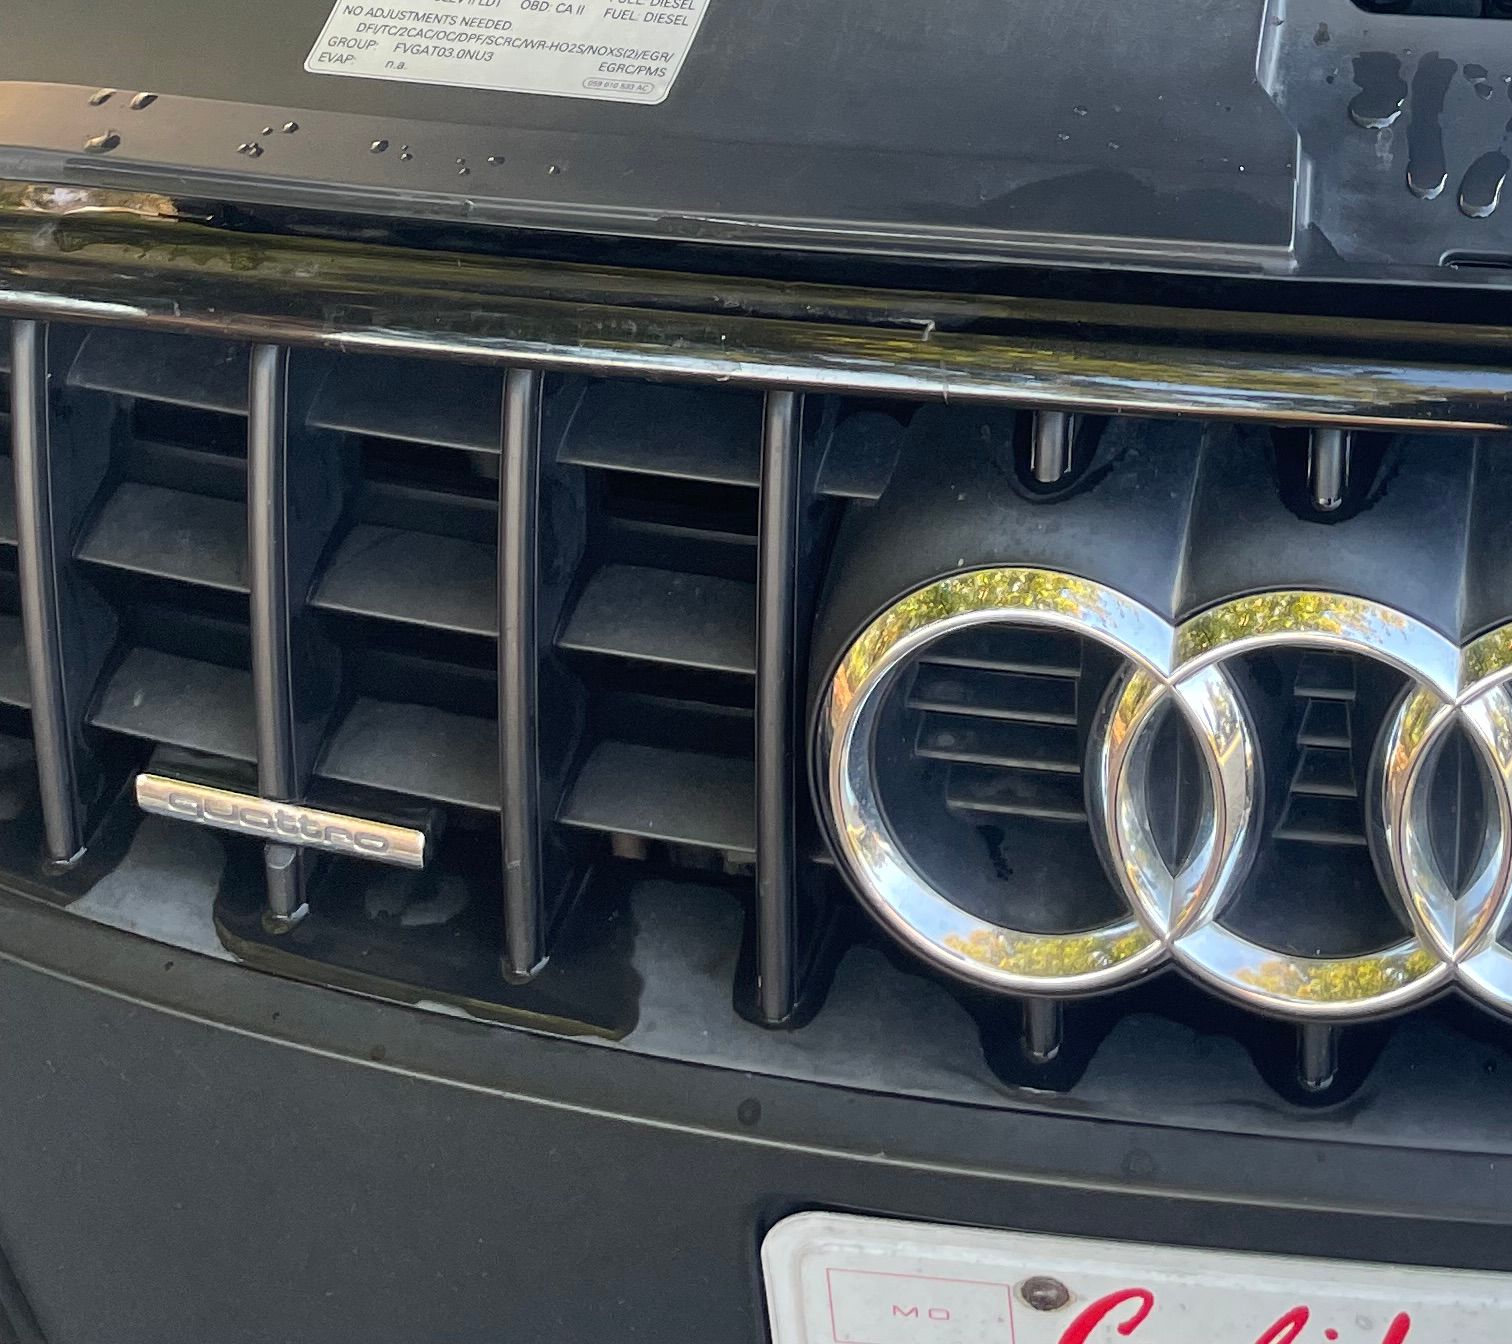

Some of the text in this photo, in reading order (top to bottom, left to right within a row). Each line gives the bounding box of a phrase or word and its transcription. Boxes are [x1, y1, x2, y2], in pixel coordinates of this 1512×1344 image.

[342, 5, 364, 16] NO
[364, 7, 458, 26] ADJUSTMENTS
[555, 2, 573, 15] CA
[643, 12, 689, 27] DIESEL
[327, 36, 379, 50] GROUP:
[318, 51, 408, 70] EVAP: n.a.
[598, 62, 667, 78] EGRC/PMS
[168, 792, 389, 853] quattro
